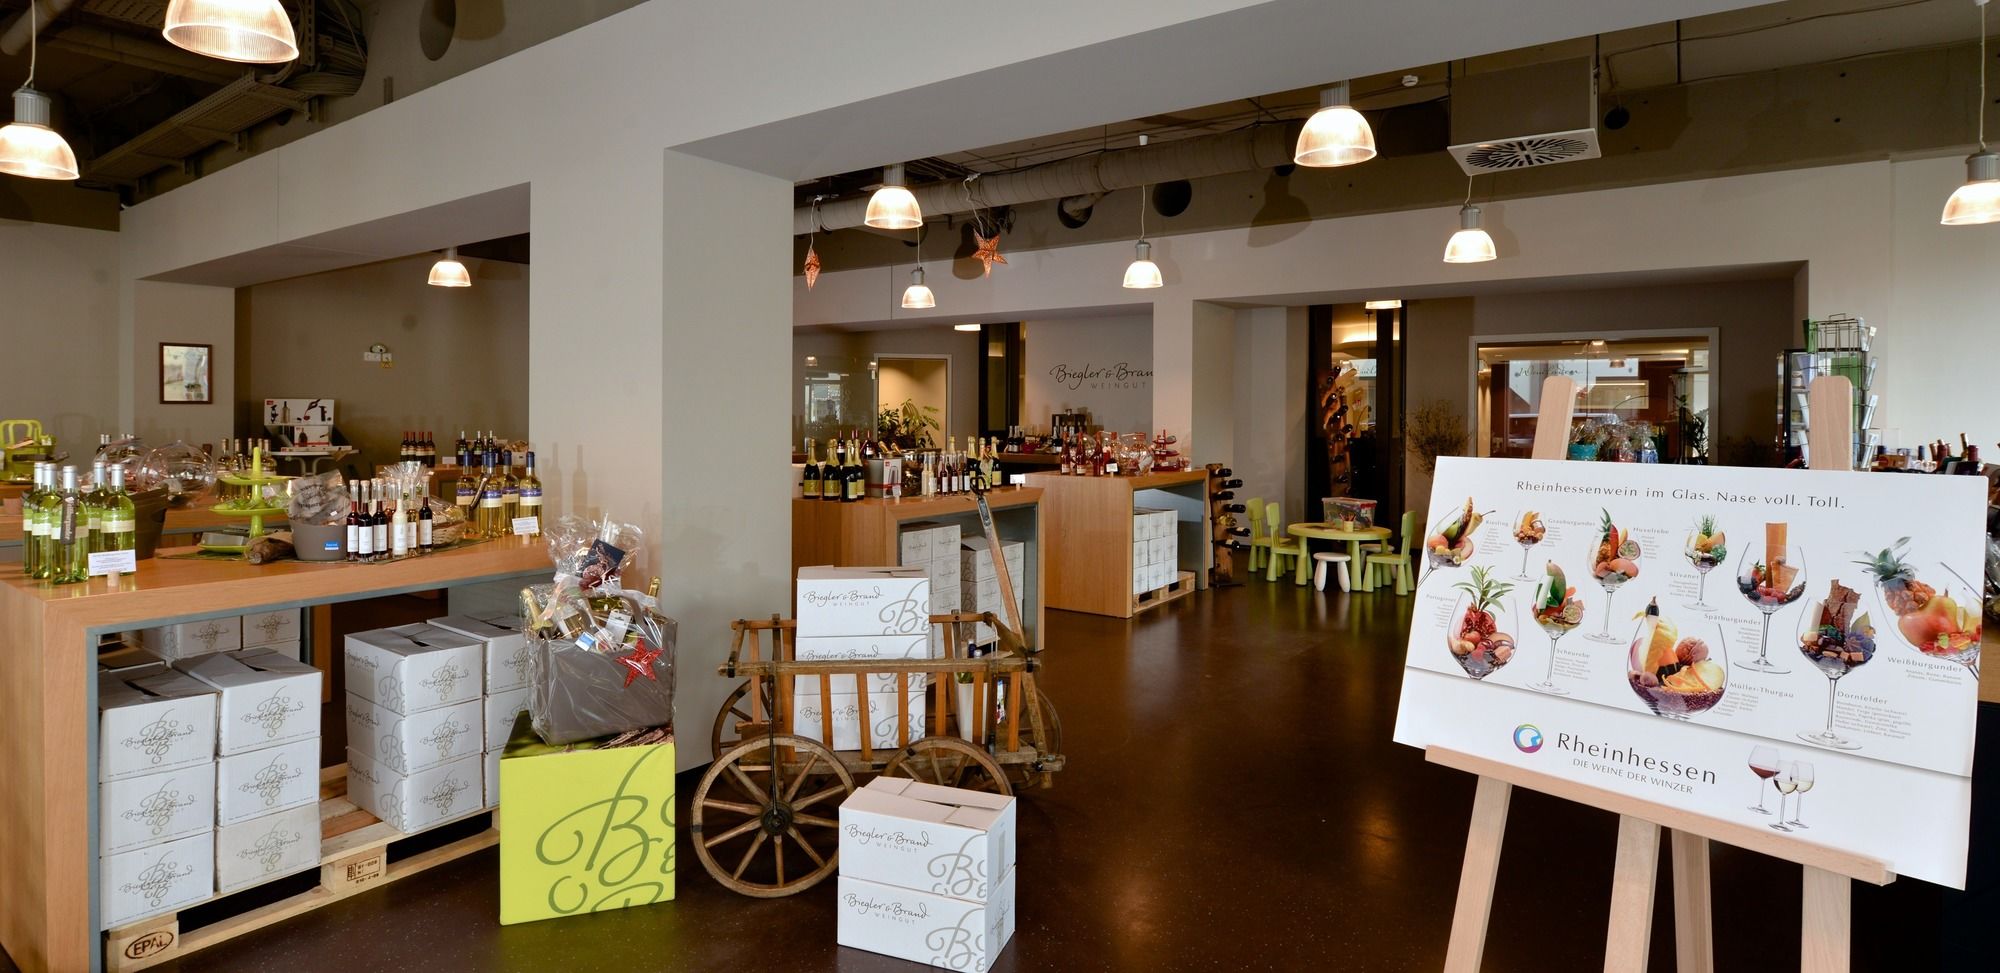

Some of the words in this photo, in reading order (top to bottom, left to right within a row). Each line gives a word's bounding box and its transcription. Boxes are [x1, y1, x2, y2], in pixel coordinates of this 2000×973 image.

[1049, 363, 1105, 390] Biegler
[1113, 362, 1153, 381] Bran
[1516, 480, 1638, 497] Rheinhessenwein
[1646, 487, 1664, 498] im
[1672, 488, 1710, 501] Glas.
[1716, 491, 1756, 504] Nase
[1764, 494, 1800, 506] voll.
[1807, 495, 1845, 509] Toll.
[1669, 571, 1699, 579] Silvaner
[803, 590, 842, 607] Biegler
[849, 586, 884, 601] Brand
[1703, 613, 1761, 625] Spätburgunder
[801, 649, 839, 661] Biegler
[845, 644, 879, 660] Brand
[1887, 656, 1962, 672] Weißburgunder
[1729, 682, 1794, 698] Müller-Thurgau
[1837, 691, 1888, 704] Dornfelder
[800, 707, 839, 723] Biegr
[845, 700, 879, 716] Brd
[1557, 732, 1717, 784] Rheinhessen
[1572, 758, 1589, 769] DIE
[1591, 762, 1624, 778] WEINE
[1626, 771, 1647, 783] DER
[1650, 777, 1694, 795] WINZER
[845, 824, 887, 845] Biegler
[892, 830, 933, 848] Brand
[876, 842, 918, 853] WEINGUT
[843, 893, 885, 915] Biegler
[891, 902, 931, 919] Brand
[874, 913, 915, 925] WEINGUT
